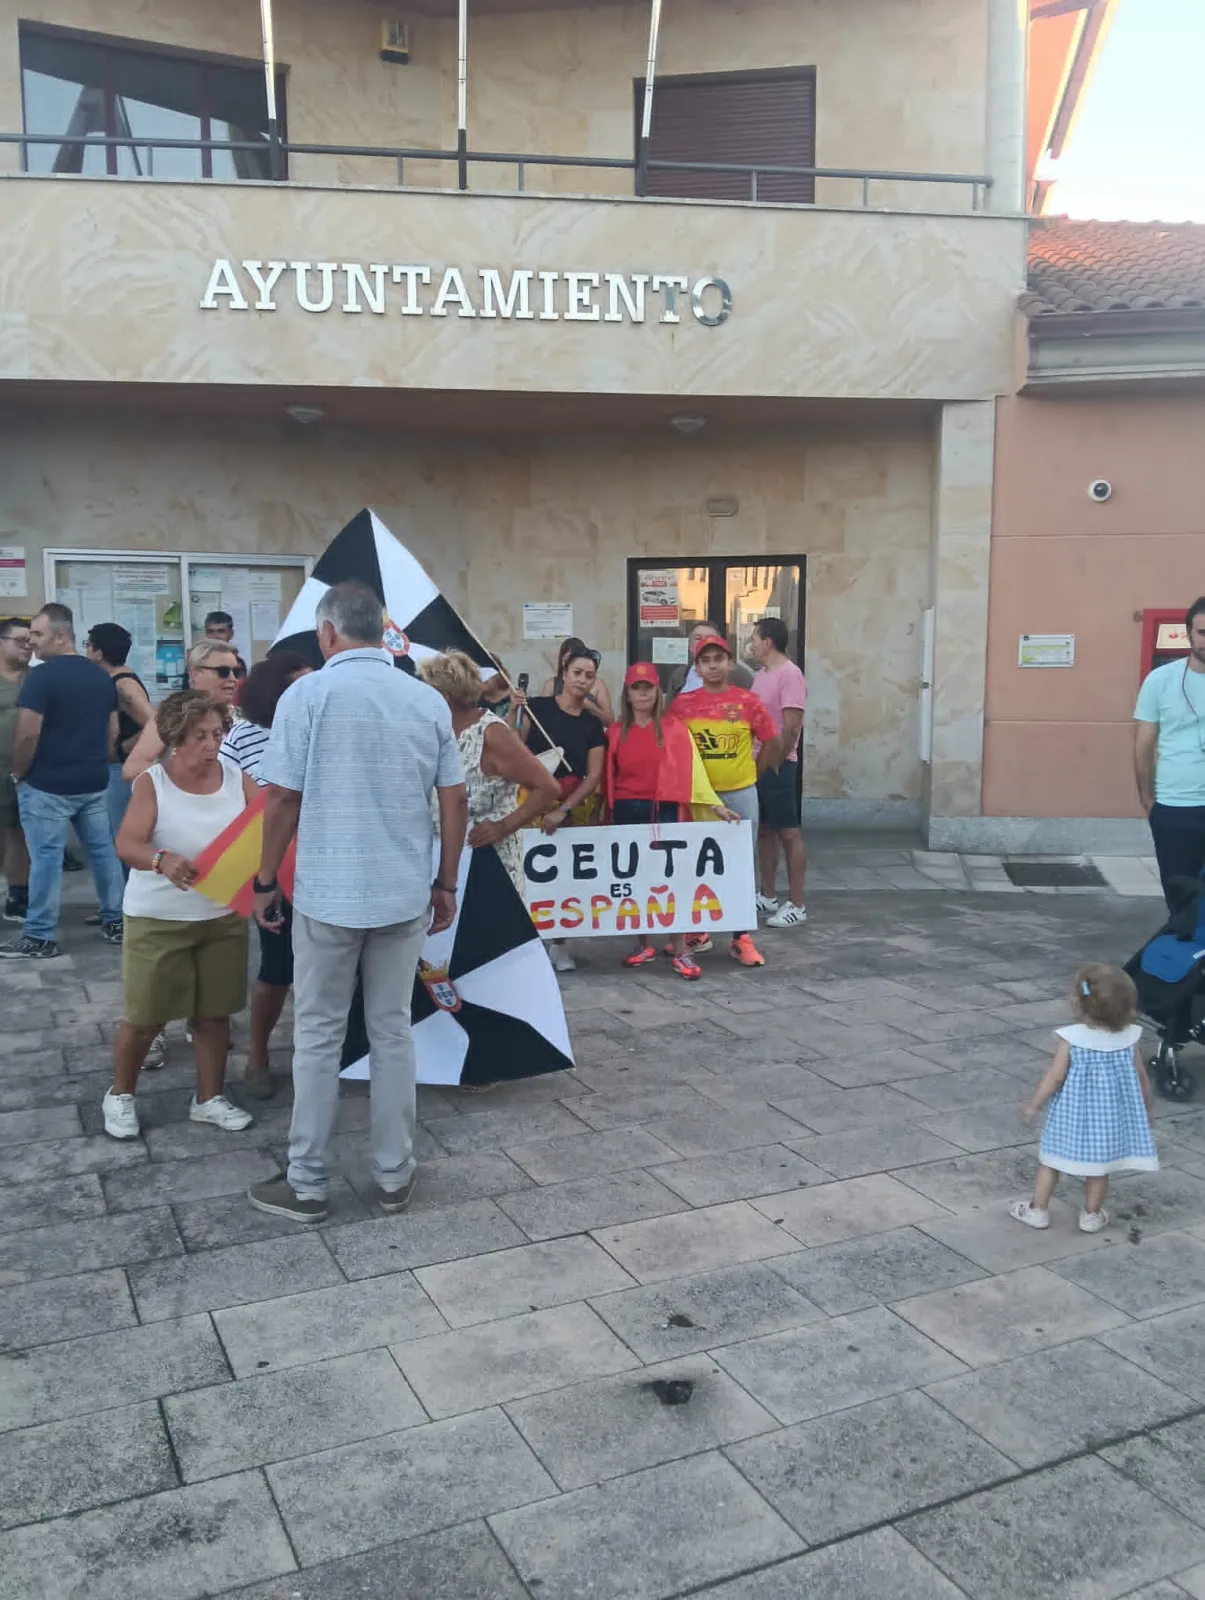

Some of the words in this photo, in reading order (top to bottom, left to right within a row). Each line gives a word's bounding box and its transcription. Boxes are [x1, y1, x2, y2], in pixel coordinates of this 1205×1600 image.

[199, 258, 733, 326] AYUNTAMIENTO
[524, 837, 724, 883] CEUTA
[530, 884, 723, 931] ESPAÑA
[610, 882, 632, 898] ES
